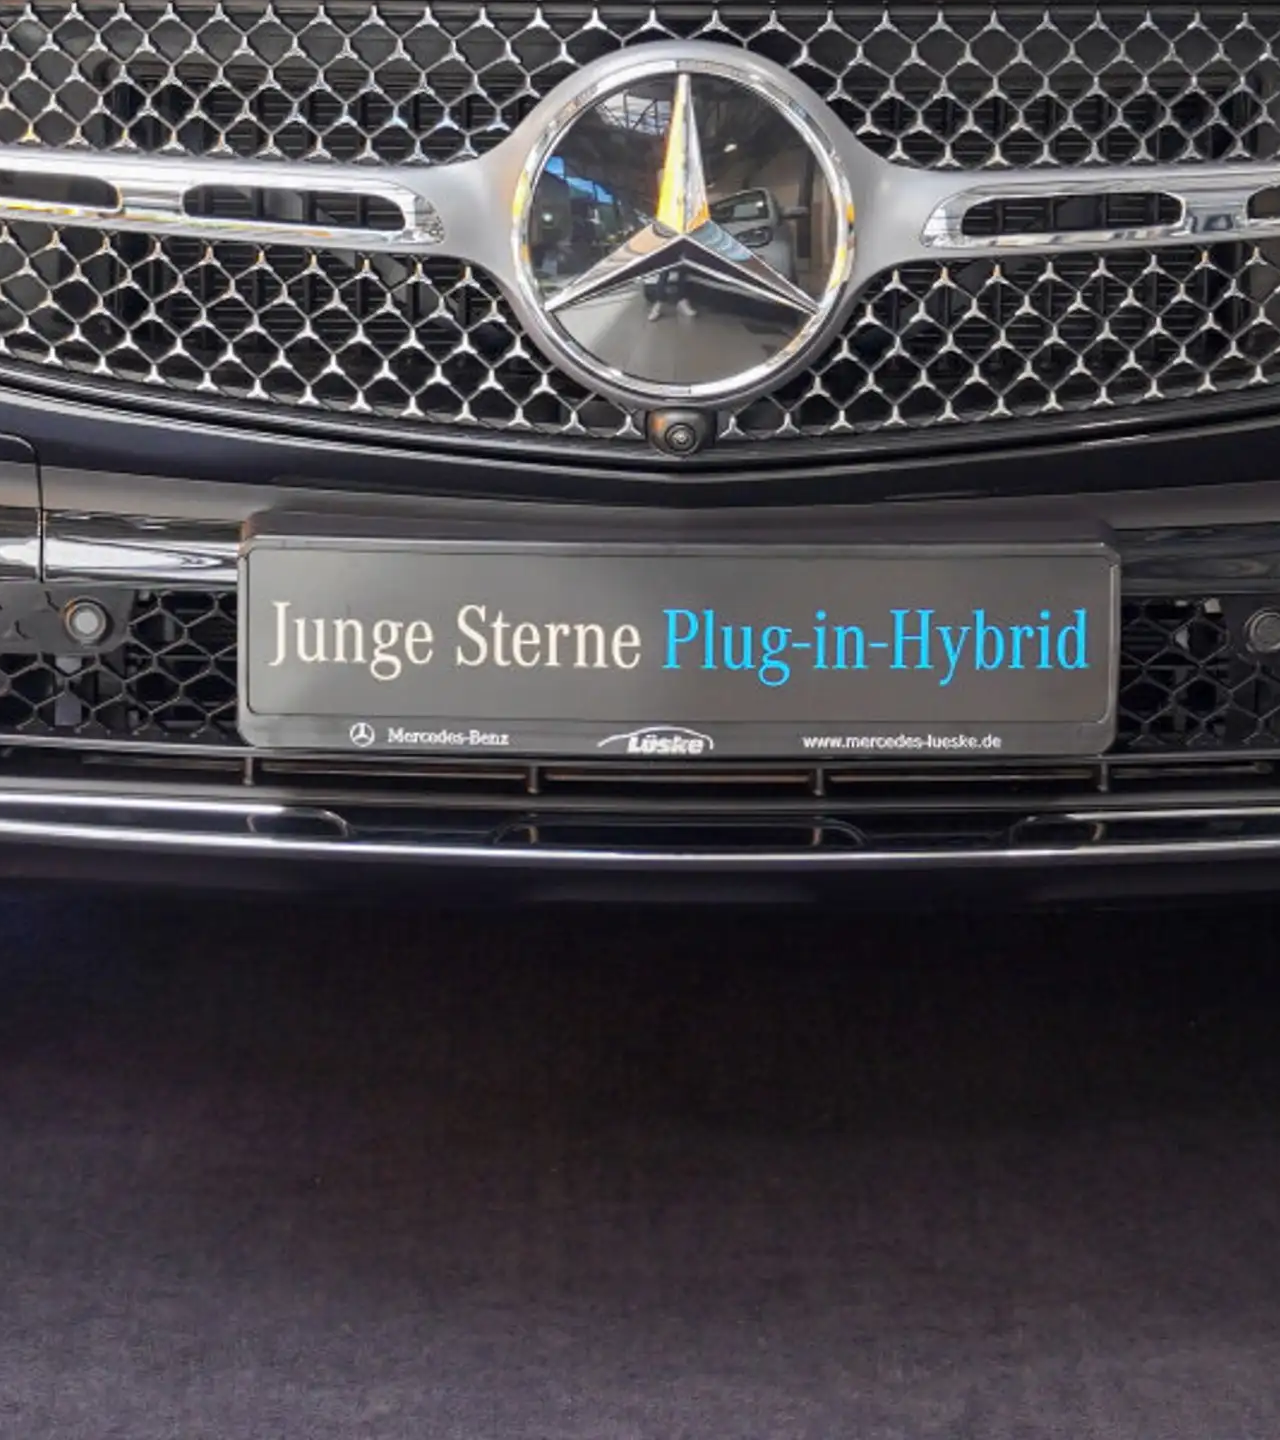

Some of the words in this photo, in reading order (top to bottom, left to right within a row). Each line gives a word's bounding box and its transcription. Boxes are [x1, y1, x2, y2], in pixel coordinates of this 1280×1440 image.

[267, 600, 434, 682] Junge
[455, 603, 642, 670] Sterne
[662, 607, 1090, 688] Plug-in-Hybrid
[387, 726, 511, 747] Mercedes-Benz
[802, 733, 1003, 750] www.mercedes-lueske.de
